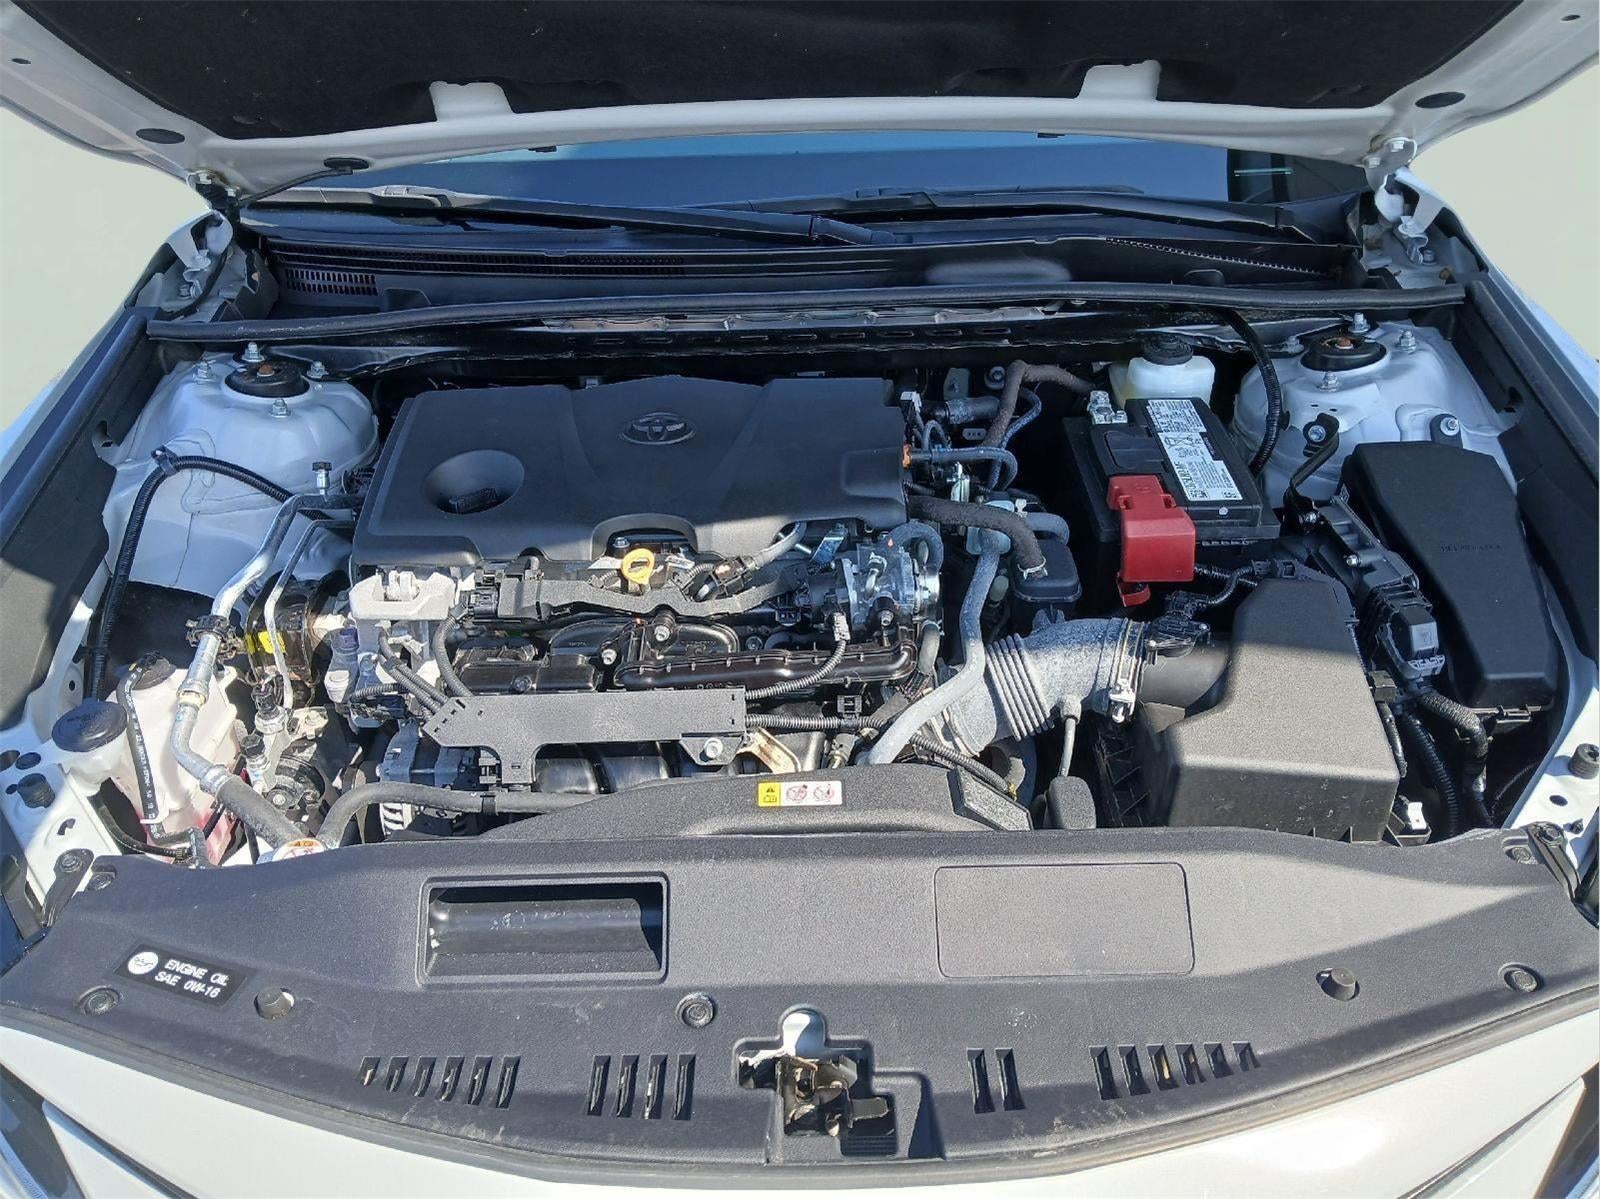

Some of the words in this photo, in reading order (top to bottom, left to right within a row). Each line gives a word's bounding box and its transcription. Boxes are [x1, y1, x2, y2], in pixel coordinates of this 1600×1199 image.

[154, 972, 181, 986] SAE
[164, 959, 208, 979] ENGINE
[210, 973, 229, 987] OIL
